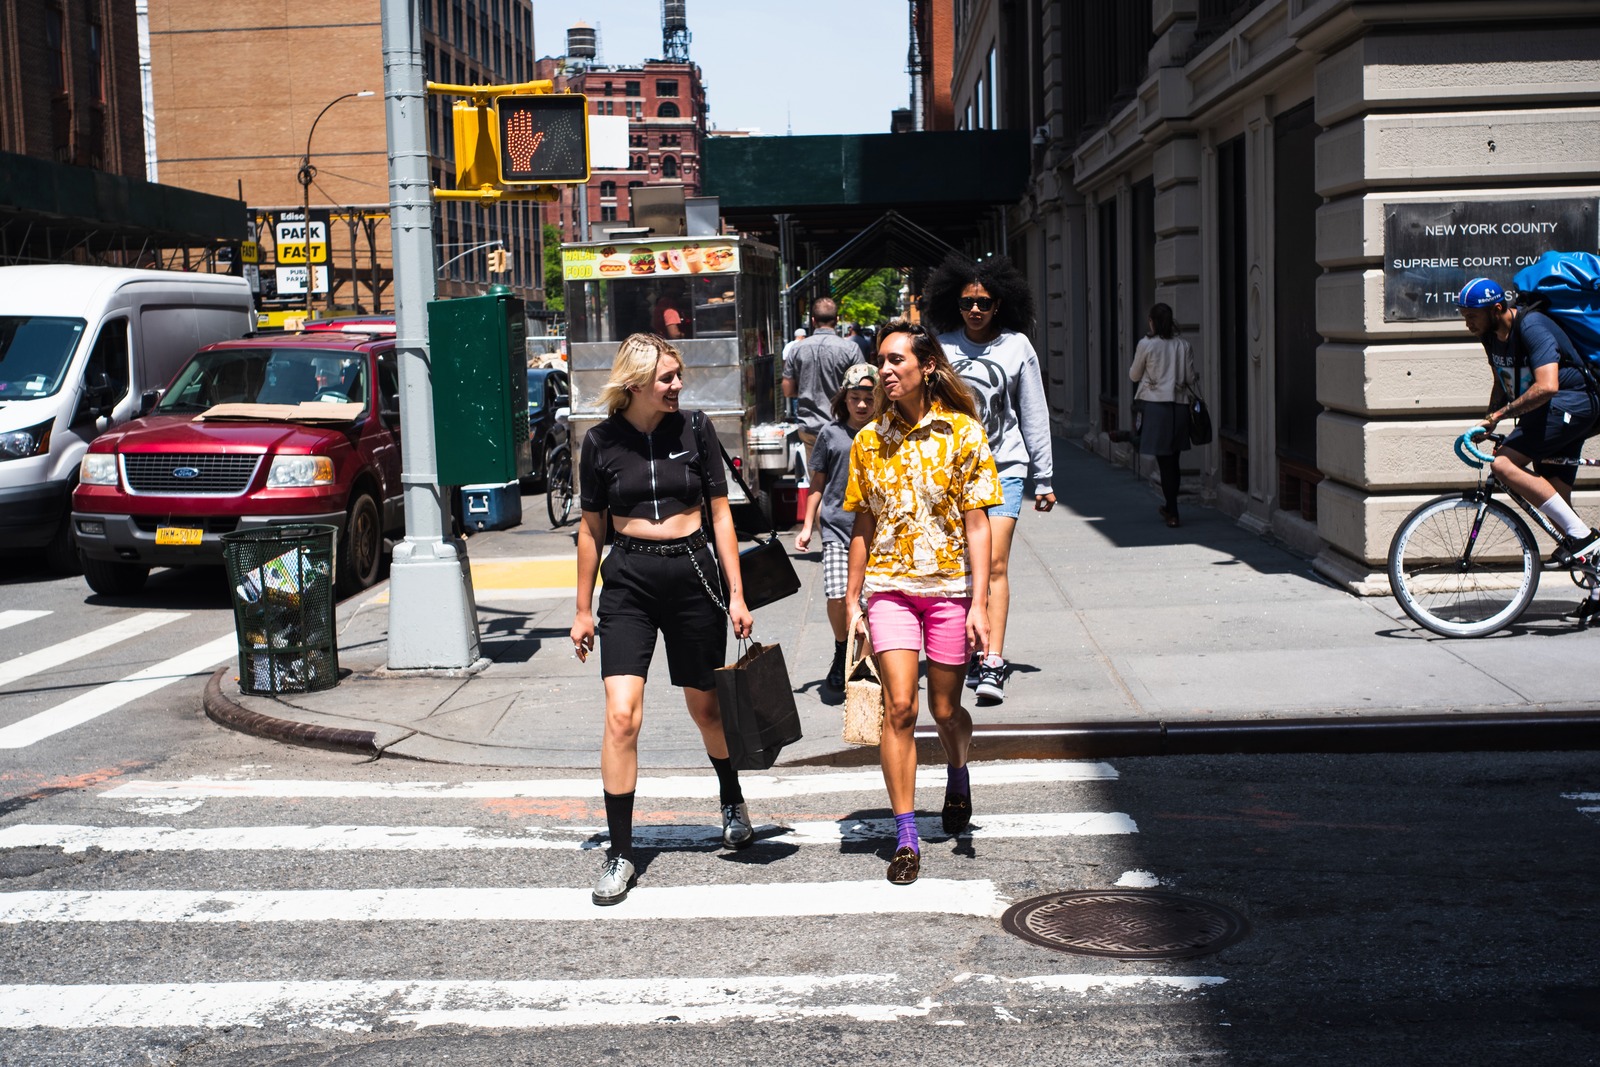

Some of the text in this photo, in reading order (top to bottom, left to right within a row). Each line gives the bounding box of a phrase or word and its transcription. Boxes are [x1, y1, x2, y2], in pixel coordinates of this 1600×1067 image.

[280, 212, 309, 221] Ediso
[281, 227, 320, 239] PARK
[1425, 222, 1558, 236] NEW YORK COUNTY
[243, 246, 255, 258] FAST
[283, 245, 321, 258] FAST
[565, 249, 597, 261] HALAL
[1393, 255, 1541, 269] SUPREME COURT, CIV
[565, 265, 593, 278] FOOD
[1425, 292, 1439, 304] 71
